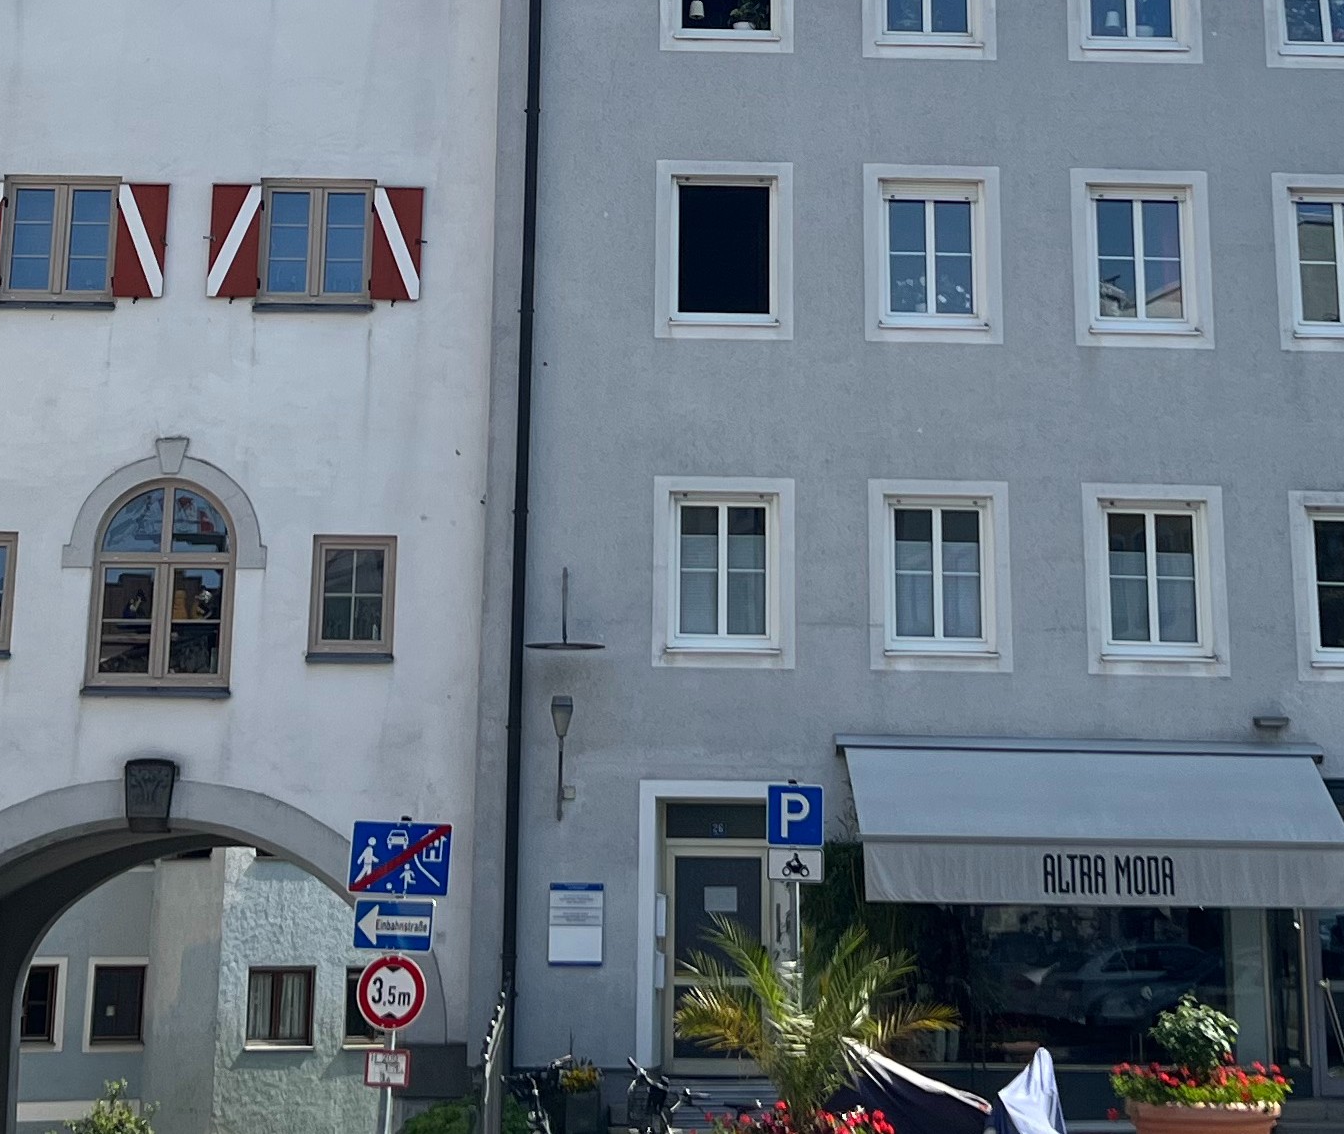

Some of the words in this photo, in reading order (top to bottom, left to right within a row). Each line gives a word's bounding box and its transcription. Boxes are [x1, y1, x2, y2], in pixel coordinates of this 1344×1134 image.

[780, 792, 810, 839] P
[1043, 853, 1107, 896] ALTRA
[1114, 854, 1175, 897] MODA
[376, 919, 428, 933] Einbahnstraße
